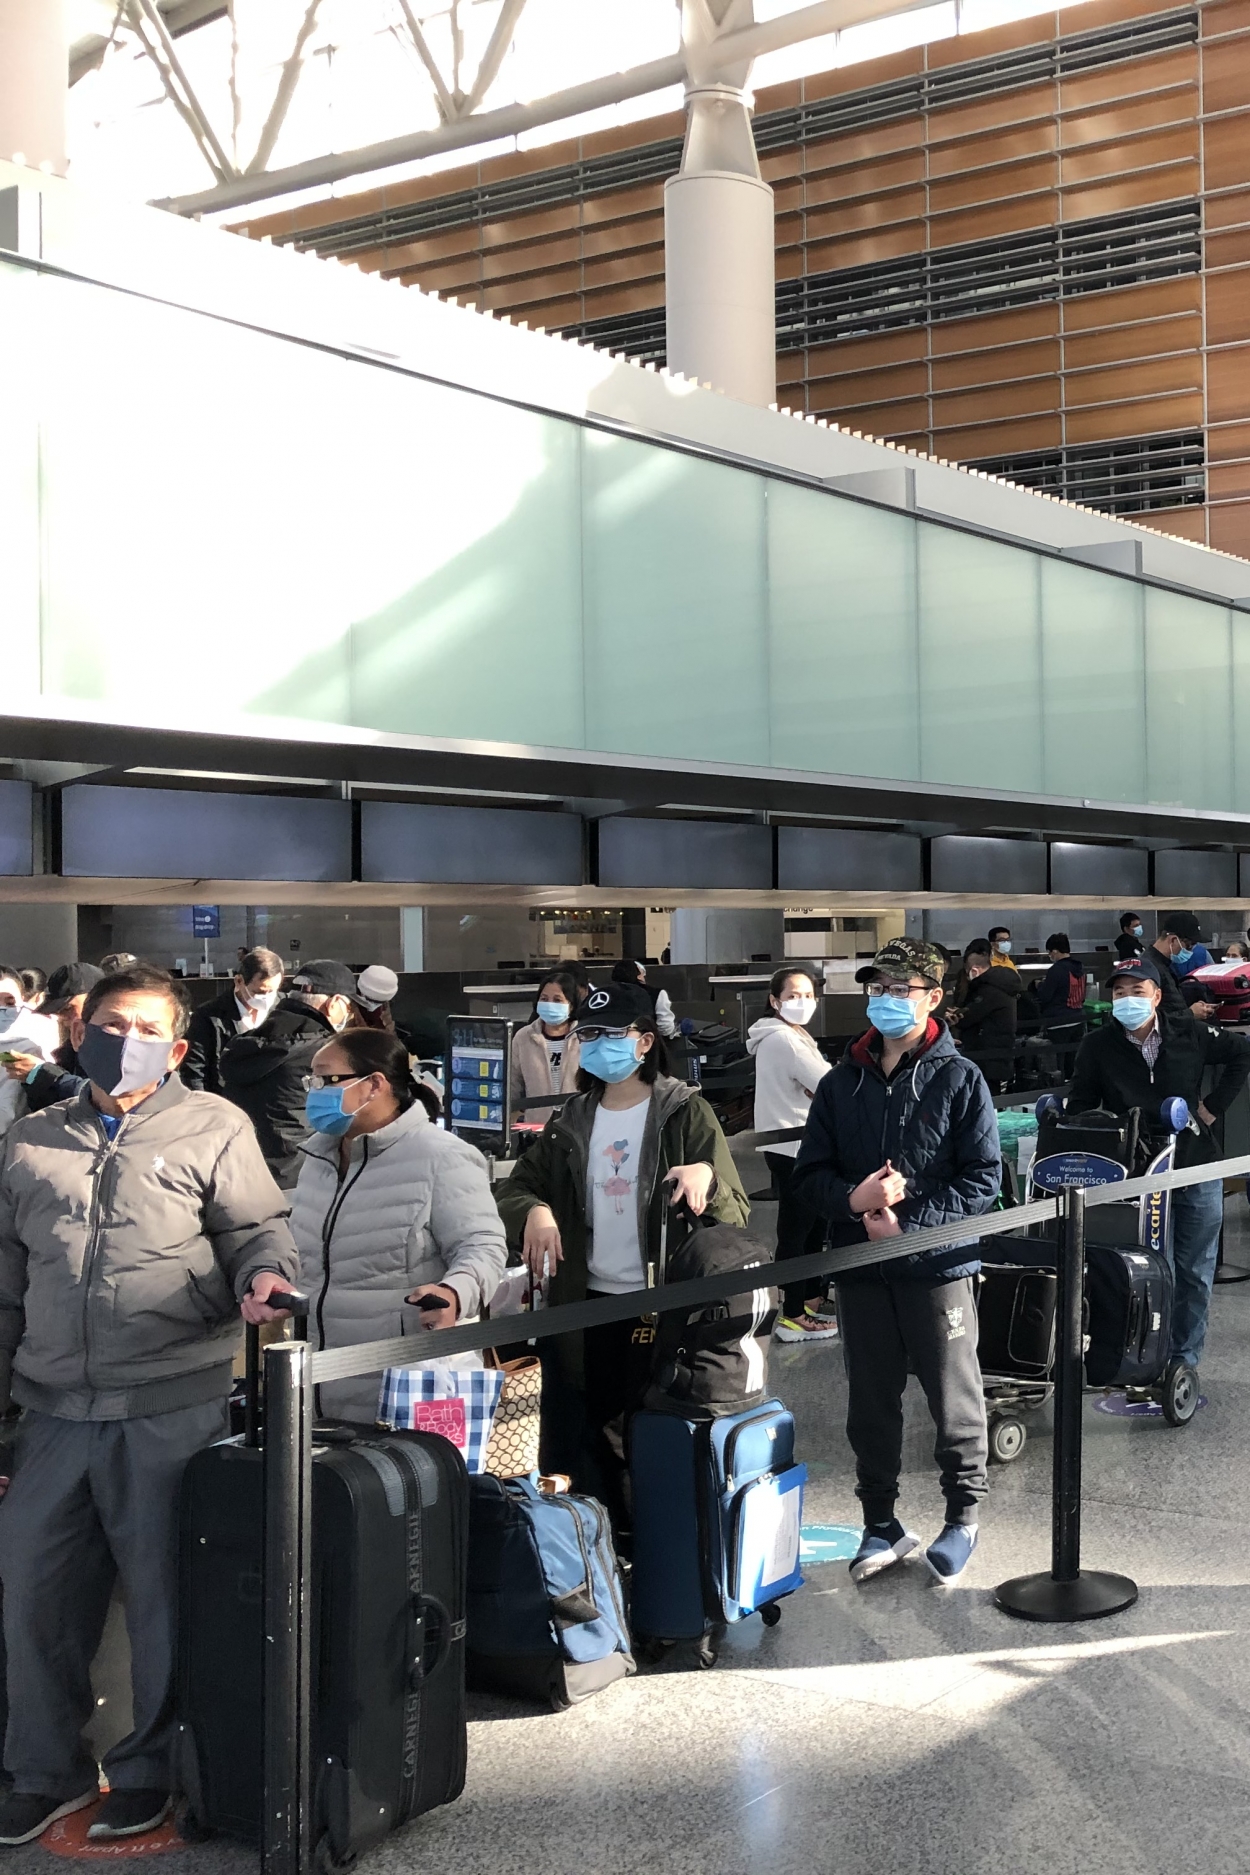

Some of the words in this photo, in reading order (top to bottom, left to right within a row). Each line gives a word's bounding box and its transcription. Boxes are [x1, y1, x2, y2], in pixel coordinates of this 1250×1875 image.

[889, 939, 916, 957] VEGAS
[1059, 1165, 1086, 1173] Welcome
[1045, 1173, 1062, 1184] San
[1064, 1174, 1107, 1185] Francisco
[631, 1327, 656, 1344] FEN
[416, 1403, 463, 1425] Bath
[427, 1420, 463, 1434] Body
[403, 1690, 419, 1778] CARNEGI
